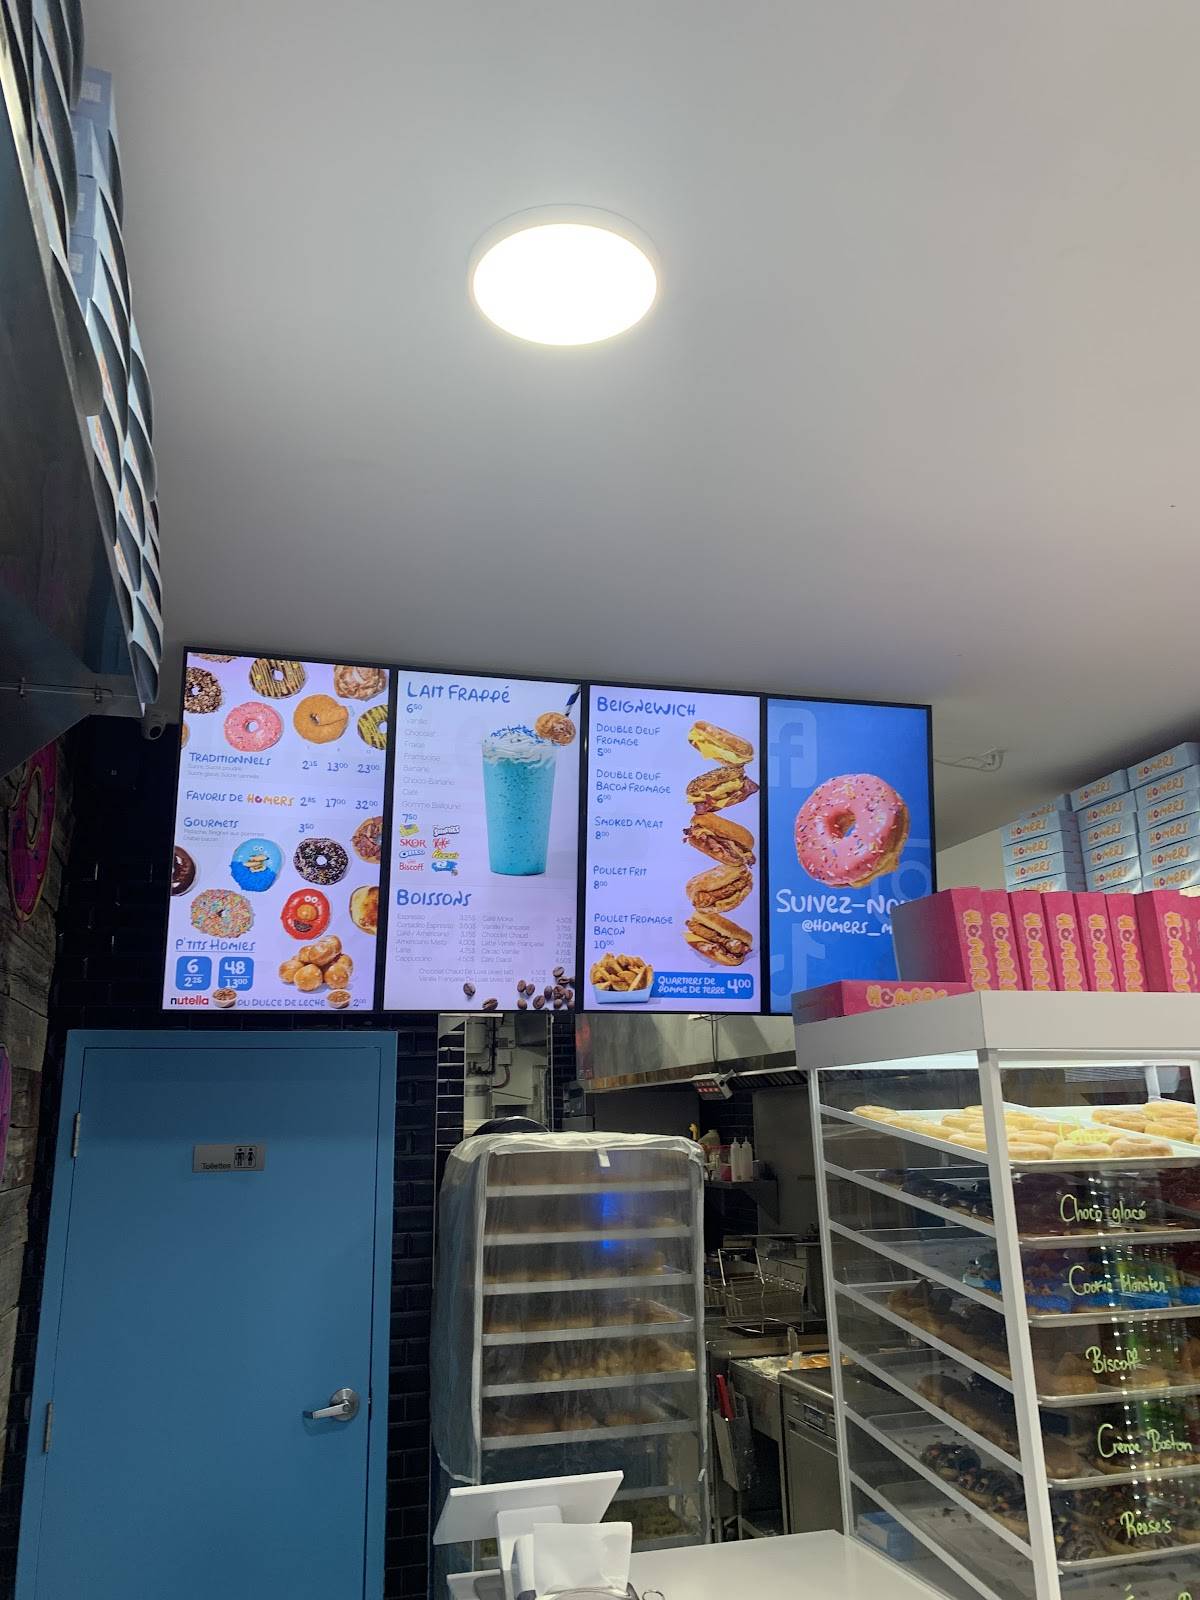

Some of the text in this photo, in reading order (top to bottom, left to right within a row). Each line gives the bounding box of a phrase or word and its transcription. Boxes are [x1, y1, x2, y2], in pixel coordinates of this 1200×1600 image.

[407, 681, 511, 703] LAIT FRAPPÉ
[597, 696, 696, 717] BEIGNEWICH
[596, 723, 633, 734] DOUBLE
[596, 736, 639, 746] FROMAGE
[188, 751, 272, 766] TRADITIONNELS
[596, 769, 633, 780] DOUBLE
[596, 781, 671, 793] BACON FROMAGE
[186, 790, 295, 807] FAVORIS DE HOMERS
[184, 817, 239, 829] GOURMETS
[595, 815, 664, 828] SMOKED MEAT
[400, 838, 427, 848] SKOR
[593, 865, 647, 876] POULET FRIT
[397, 889, 472, 907] BOISSONS
[776, 888, 907, 914] SUIVEZ-NO
[594, 913, 673, 924] POULET FROMAGE
[594, 926, 626, 935] BACON
[209, 939, 256, 951] HOMIES
[187, 959, 199, 974] 6
[224, 960, 246, 975] 48
[658, 976, 716, 986] QUARTIERS DE
[658, 986, 726, 995] POMME DE TERRE
[170, 995, 209, 1005] nutella
[252, 999, 282, 1007] DULCE
[285, 999, 297, 1007] DE
[298, 999, 326, 1007] LECHE
[1060, 1193, 1147, 1225] Choco glacé
[1068, 1265, 1168, 1296] Cookie Monster
[1085, 1346, 1142, 1374] Biscoff
[1098, 1423, 1193, 1458] Crème Boston
[1120, 1511, 1173, 1539] Reese's
